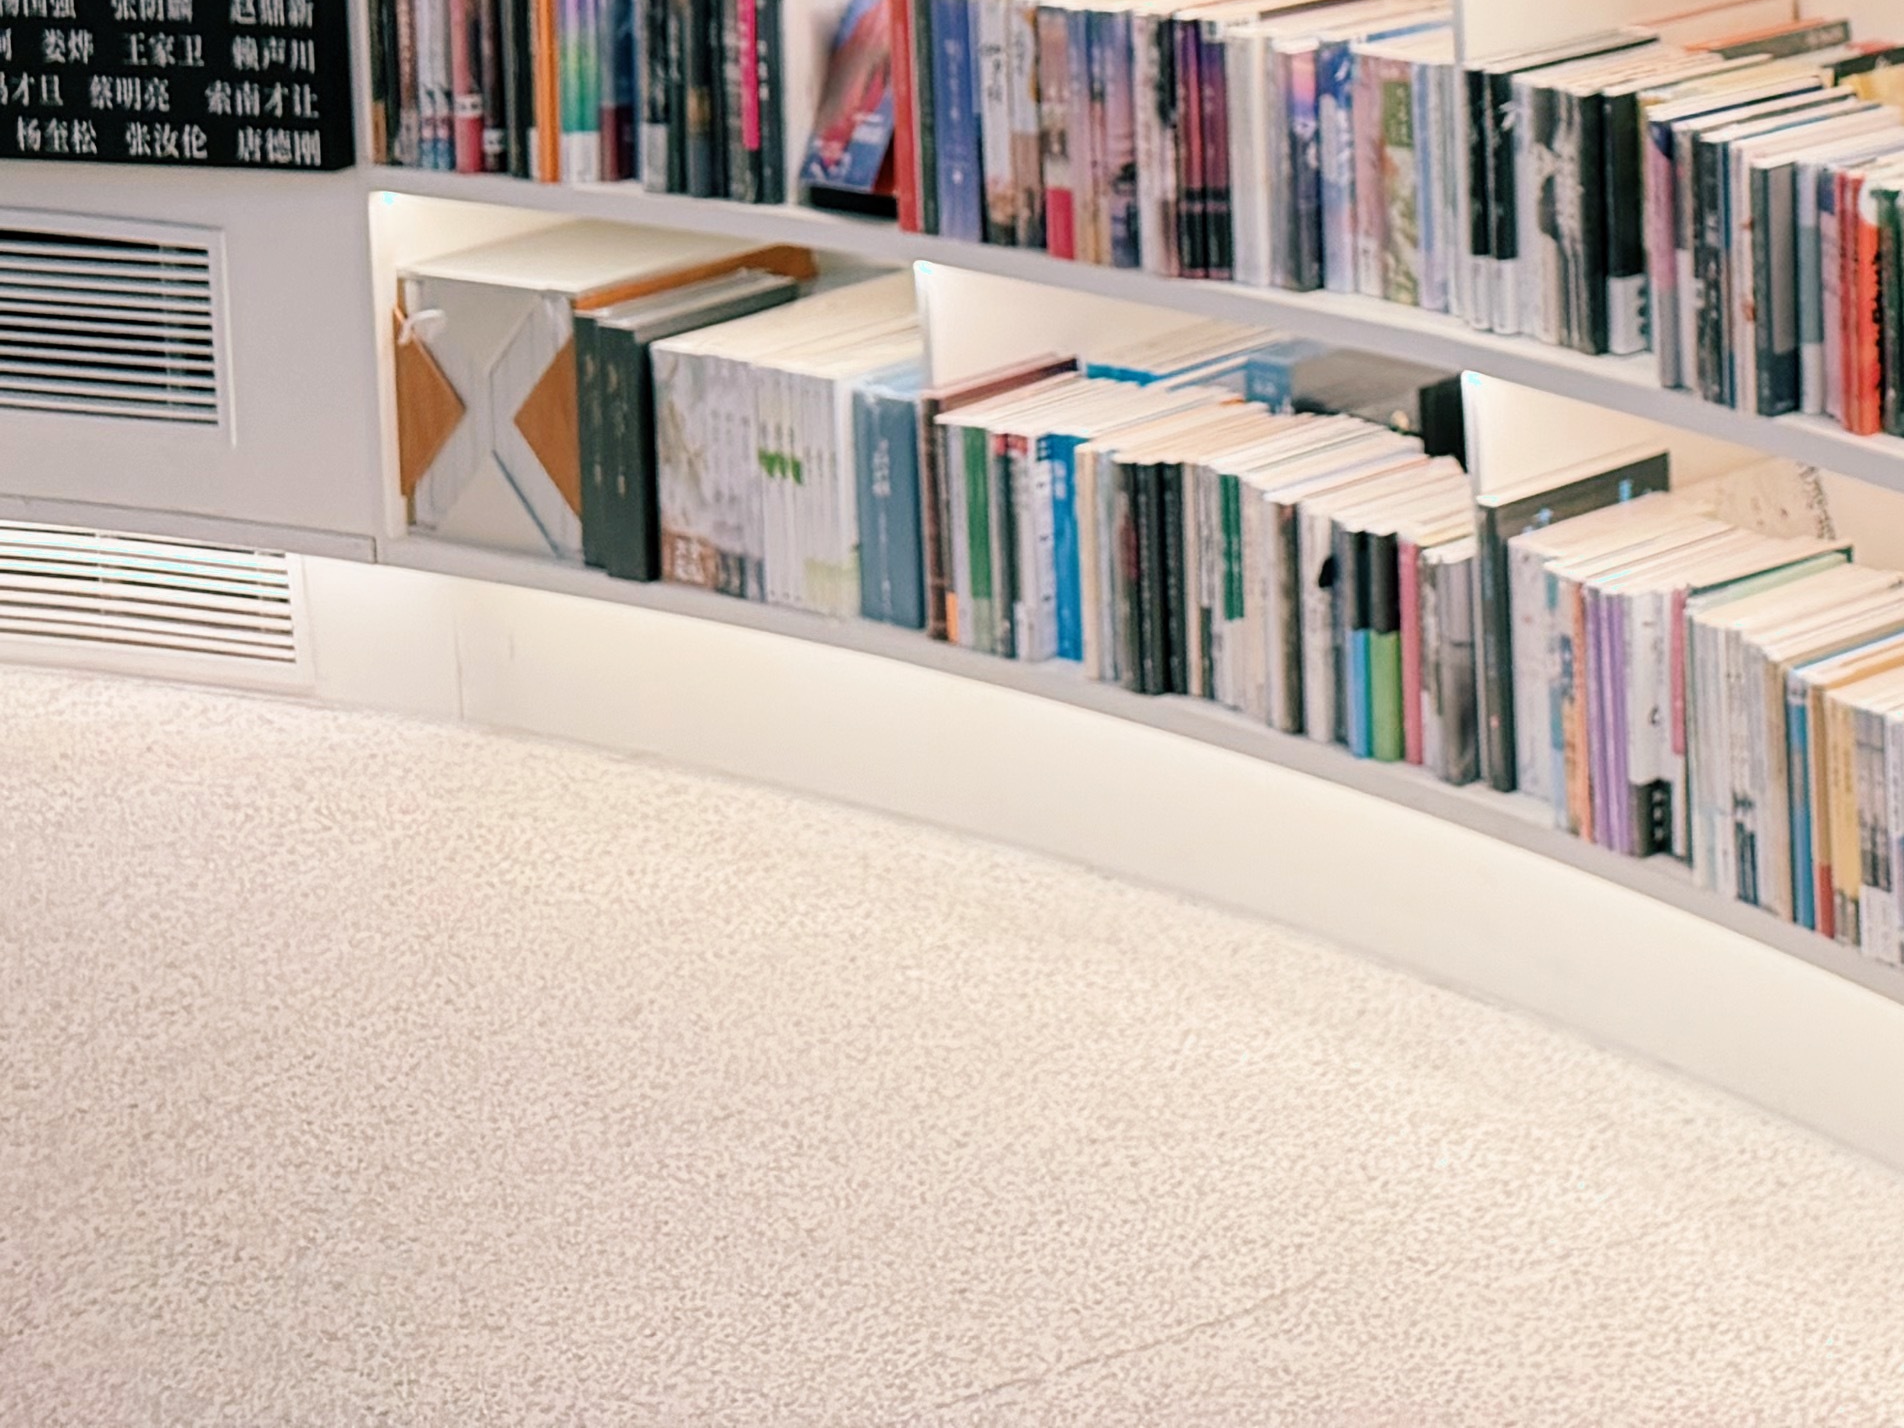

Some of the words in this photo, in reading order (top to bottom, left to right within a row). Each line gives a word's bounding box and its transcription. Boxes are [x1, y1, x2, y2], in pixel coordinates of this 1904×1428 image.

[124, 32, 204, 67] 王家卫
[232, 35, 315, 73] 赖声川
